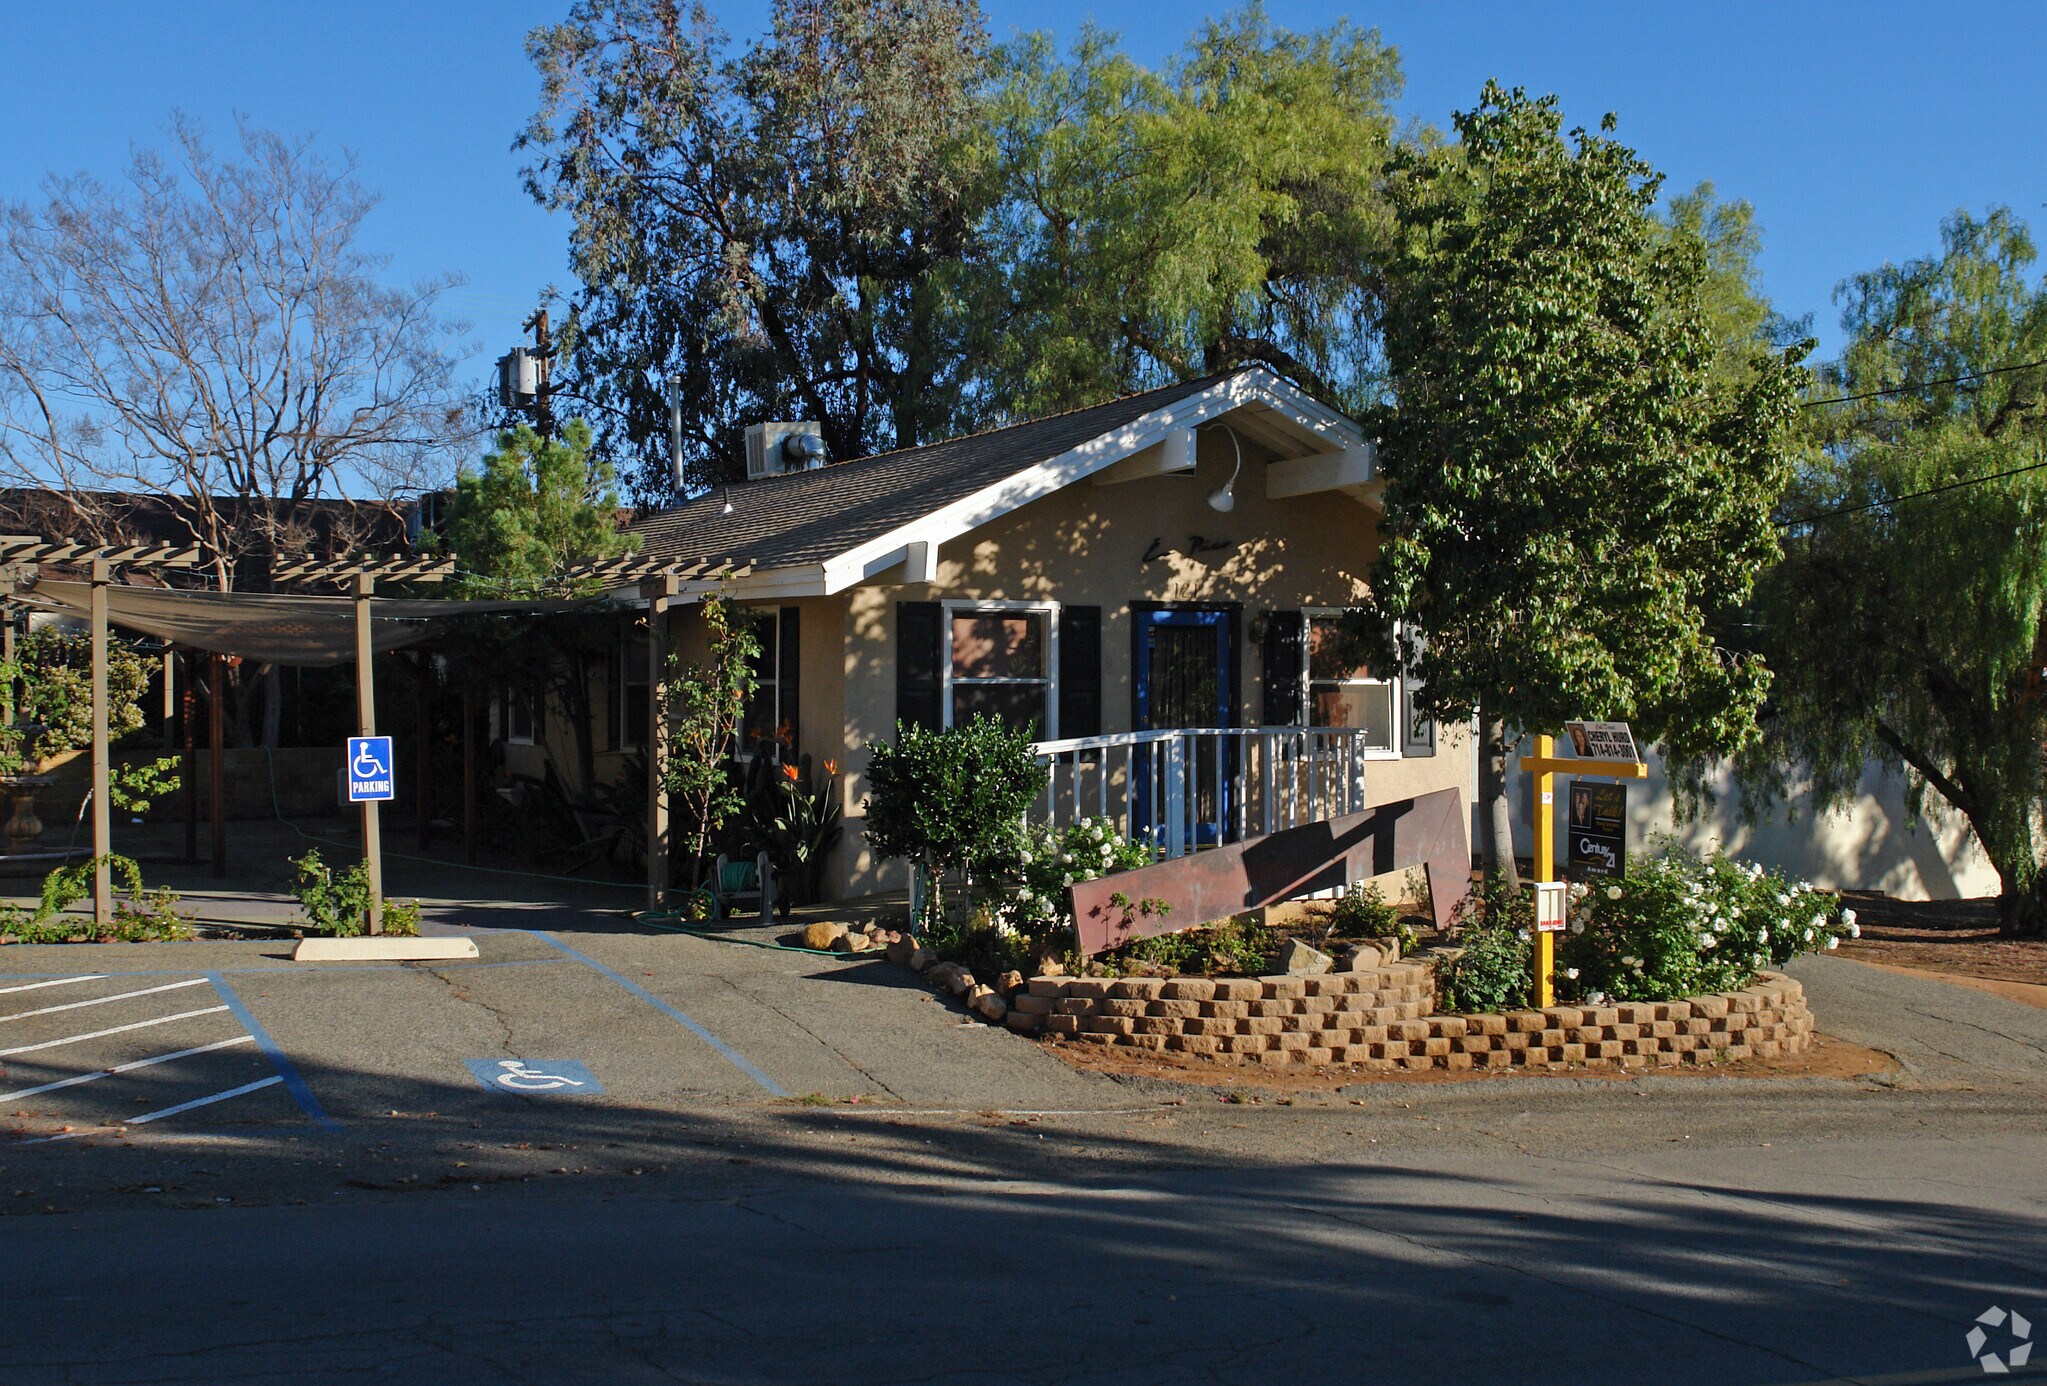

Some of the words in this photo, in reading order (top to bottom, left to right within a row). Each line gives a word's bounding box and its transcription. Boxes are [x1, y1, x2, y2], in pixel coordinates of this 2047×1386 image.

[1588, 731, 1611, 742] CHERYL
[1611, 731, 1630, 743] HURD
[353, 780, 389, 793] PARKING
[1595, 788, 1621, 801] Let's
[1593, 804, 1623, 817] Talk!
[1580, 837, 1610, 857] Century
[1606, 853, 1616, 868] 21
[1587, 866, 1608, 874] Award
